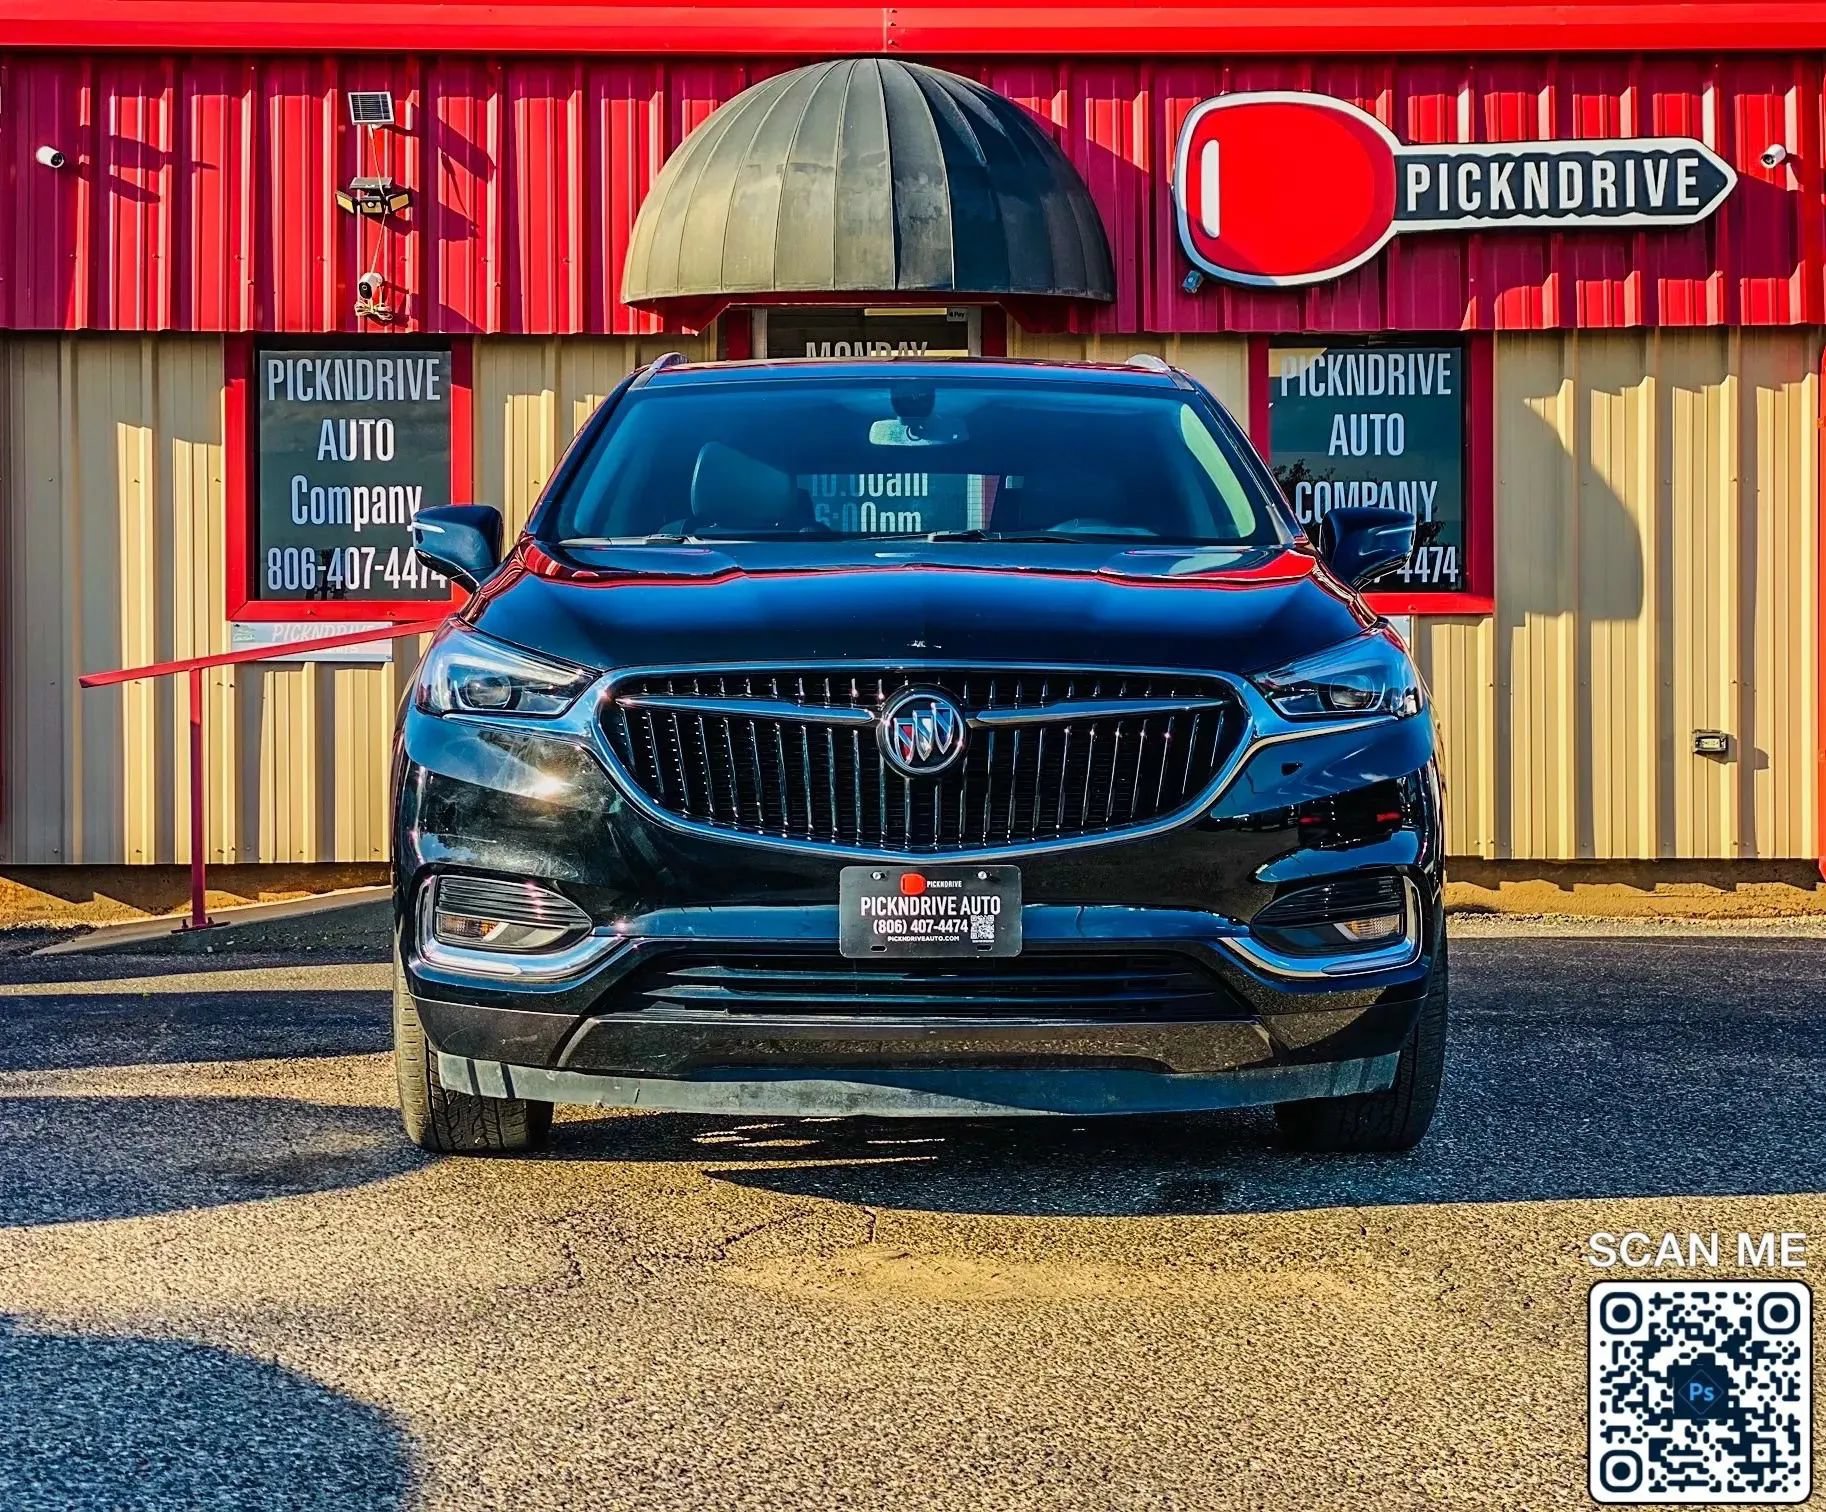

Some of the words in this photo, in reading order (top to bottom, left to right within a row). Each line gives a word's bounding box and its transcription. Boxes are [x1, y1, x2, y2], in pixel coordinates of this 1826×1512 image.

[1406, 157, 1700, 211] PICKNDRIVE
[267, 358, 441, 401] PICKNDRIVE
[1281, 353, 1450, 397] PICKNDRIVE
[317, 418, 394, 461] AUTO
[1328, 413, 1404, 456] AUTO
[291, 474, 422, 531] Company
[1295, 480, 1438, 525] COMPANY
[926, 880, 963, 888] PICKNDRIVE
[860, 896, 957, 916] PICKNDRIVE
[960, 896, 1001, 916] AUTO
[873, 919, 907, 935] (806)
[910, 919, 969, 934] 407-4474
